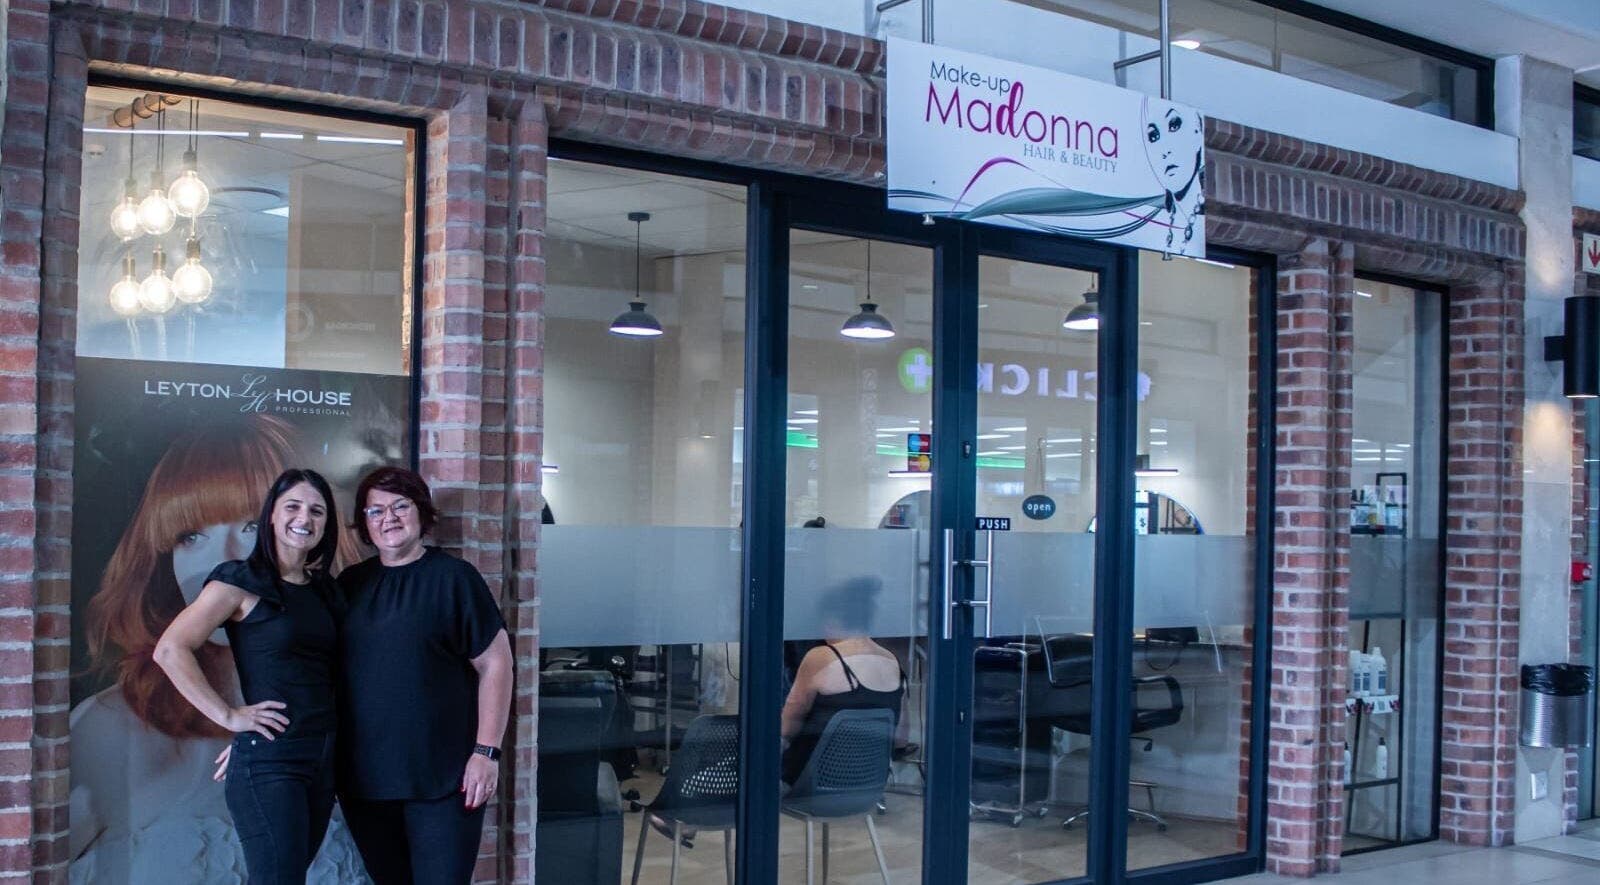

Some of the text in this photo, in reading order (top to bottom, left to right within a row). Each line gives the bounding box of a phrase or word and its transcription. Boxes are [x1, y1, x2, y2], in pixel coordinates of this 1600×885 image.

[931, 60, 1011, 96] Make-up
[926, 81, 1118, 158] Madonna
[1023, 143, 1118, 174] HAIR & BEAUTY
[144, 380, 230, 398] LEYTON
[275, 388, 352, 406] HOUSE
[275, 406, 351, 417] PROFESSIONAL
[1026, 503, 1051, 515] open
[979, 519, 1008, 529] PUSH
